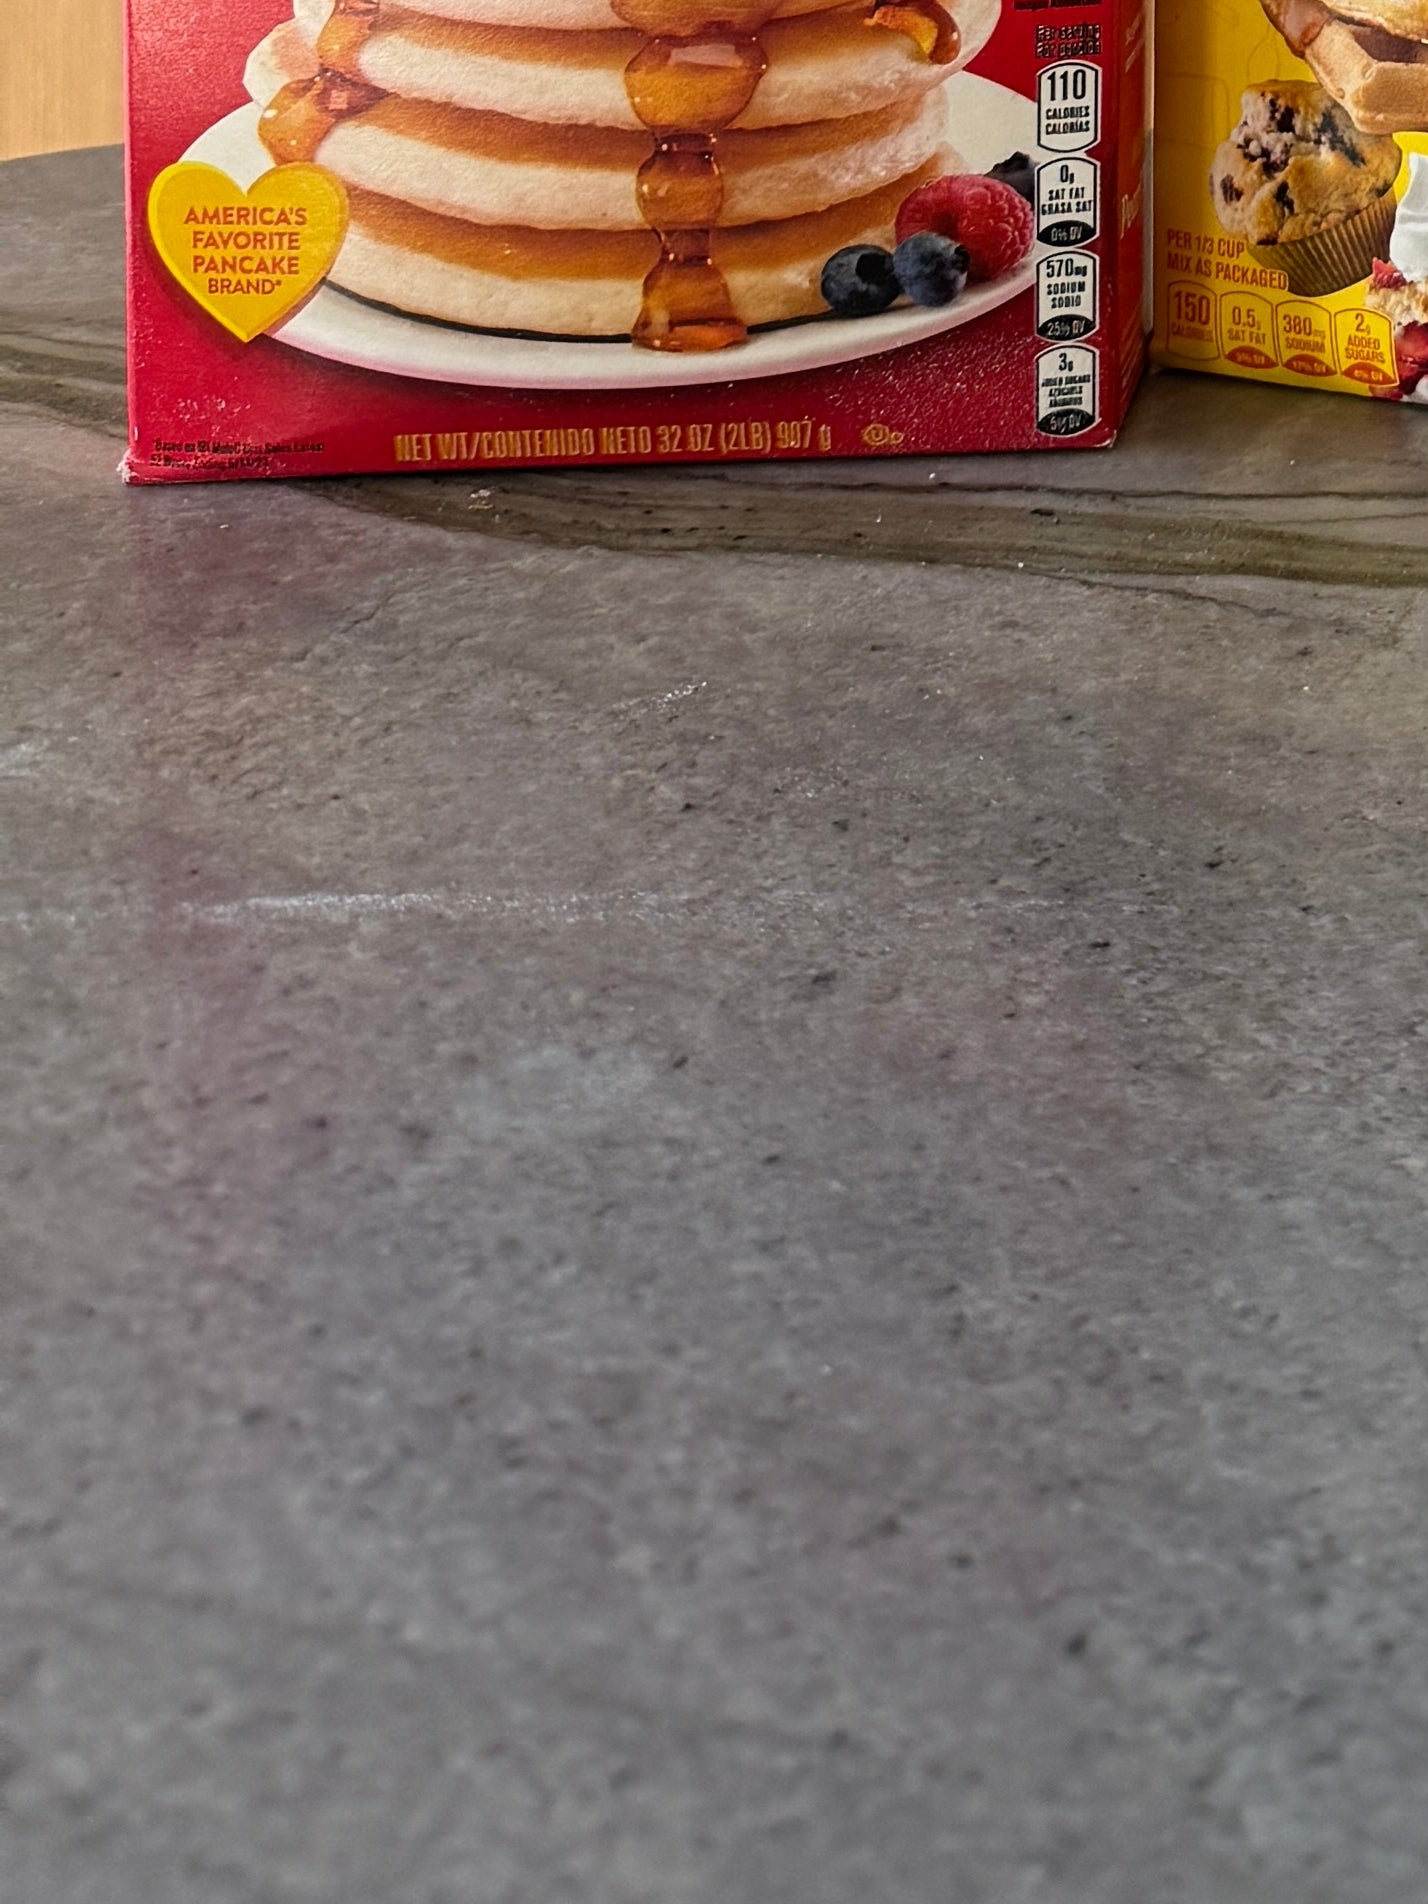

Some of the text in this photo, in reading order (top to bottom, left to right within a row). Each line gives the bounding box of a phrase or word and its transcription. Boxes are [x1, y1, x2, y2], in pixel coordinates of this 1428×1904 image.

[1046, 69, 1086, 101] 110
[184, 206, 307, 225] AMERICA'S
[192, 231, 300, 250] FAVORITE
[1167, 229, 1245, 259] PER 1/3 CUP
[192, 255, 300, 275] PANCAKE
[1167, 252, 1288, 291] MIX AS PACKAGED
